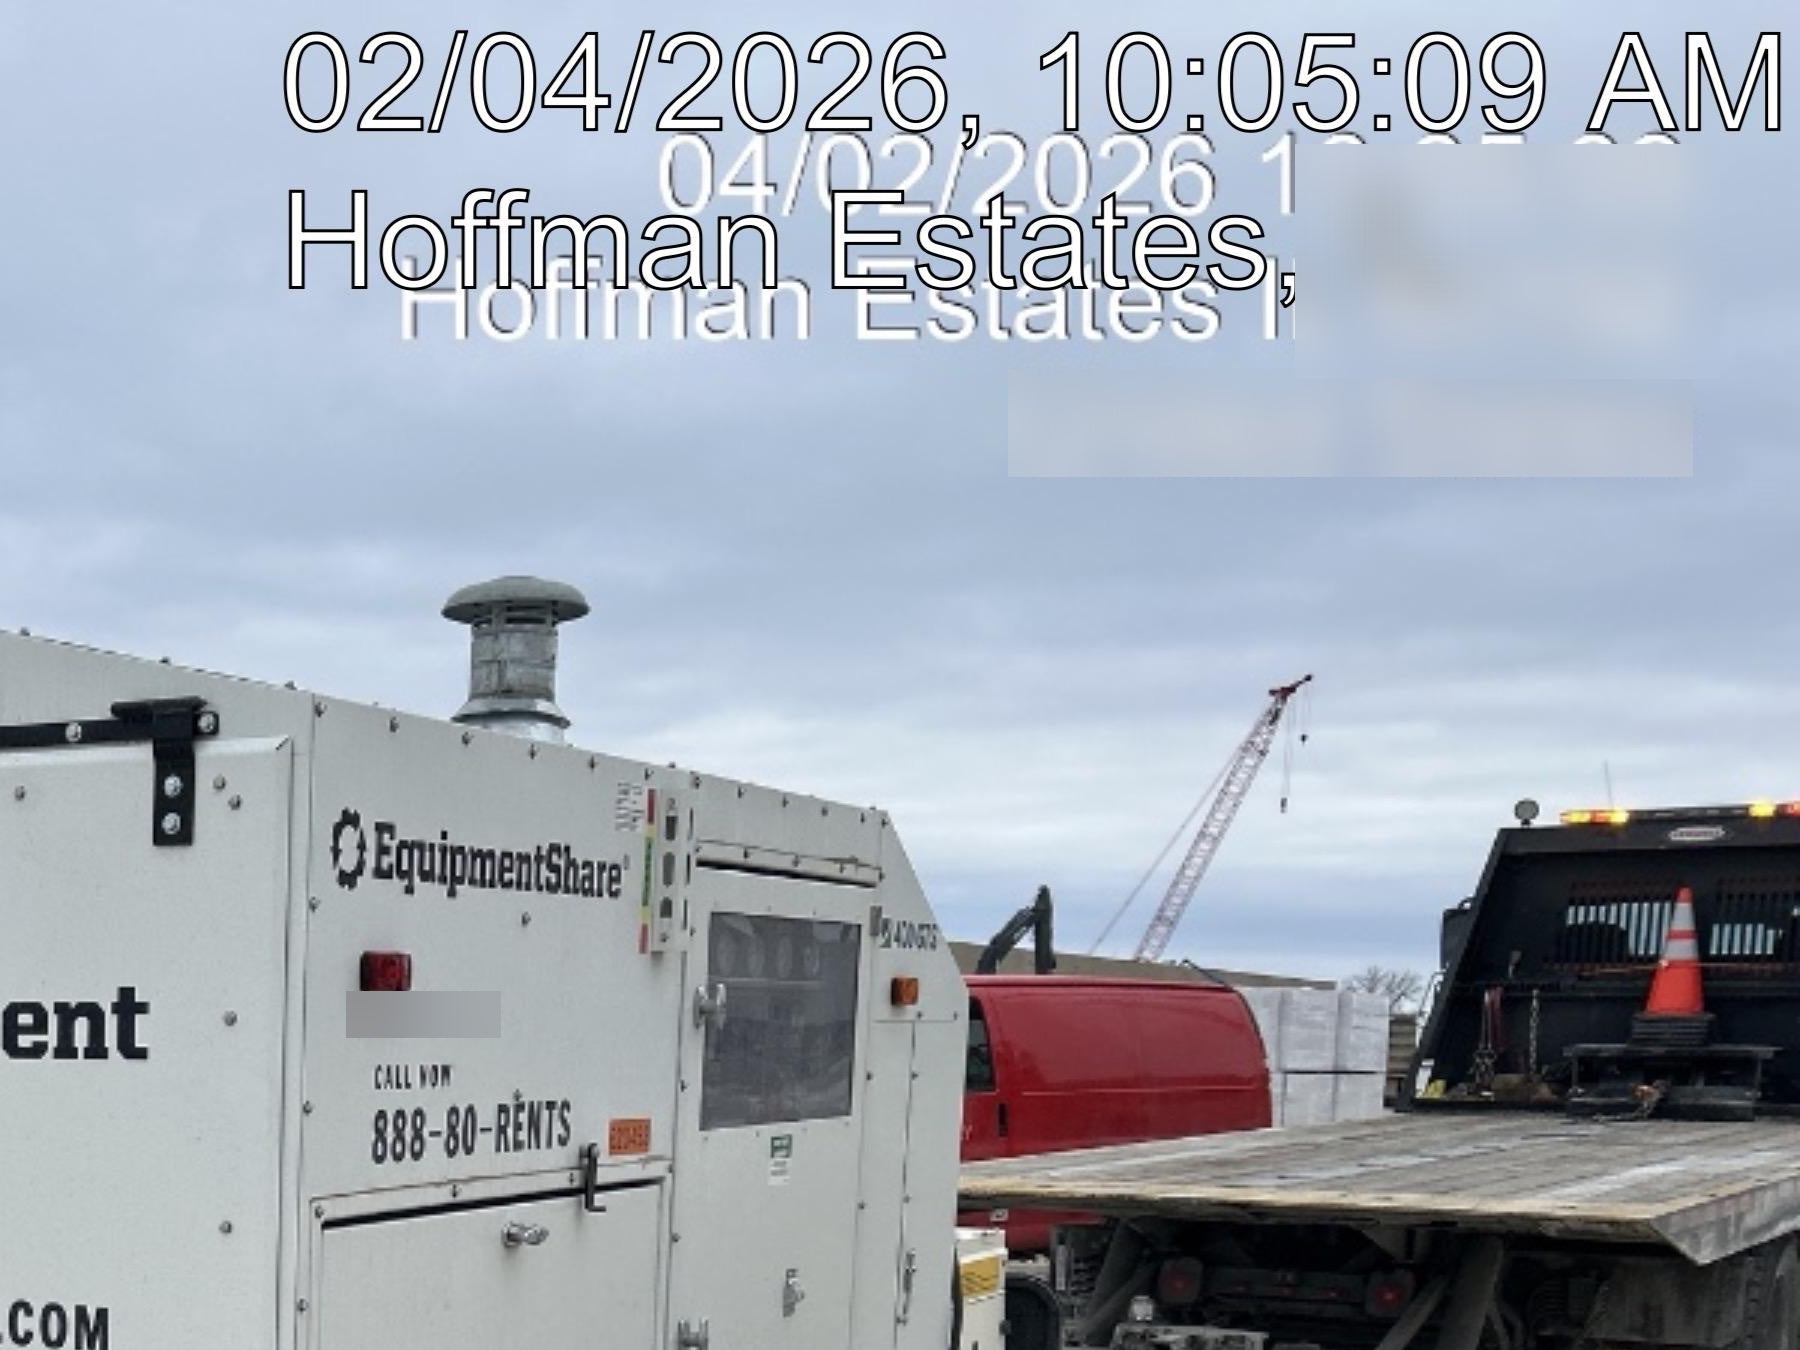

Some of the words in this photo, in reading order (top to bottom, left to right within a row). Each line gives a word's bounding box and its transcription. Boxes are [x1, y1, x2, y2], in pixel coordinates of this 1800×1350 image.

[372, 821, 623, 899] EquipmentShare
[374, 1064, 412, 1090] CALL
[419, 1064, 452, 1089] NOW
[371, 1098, 572, 1165] 888-80-RENTS
